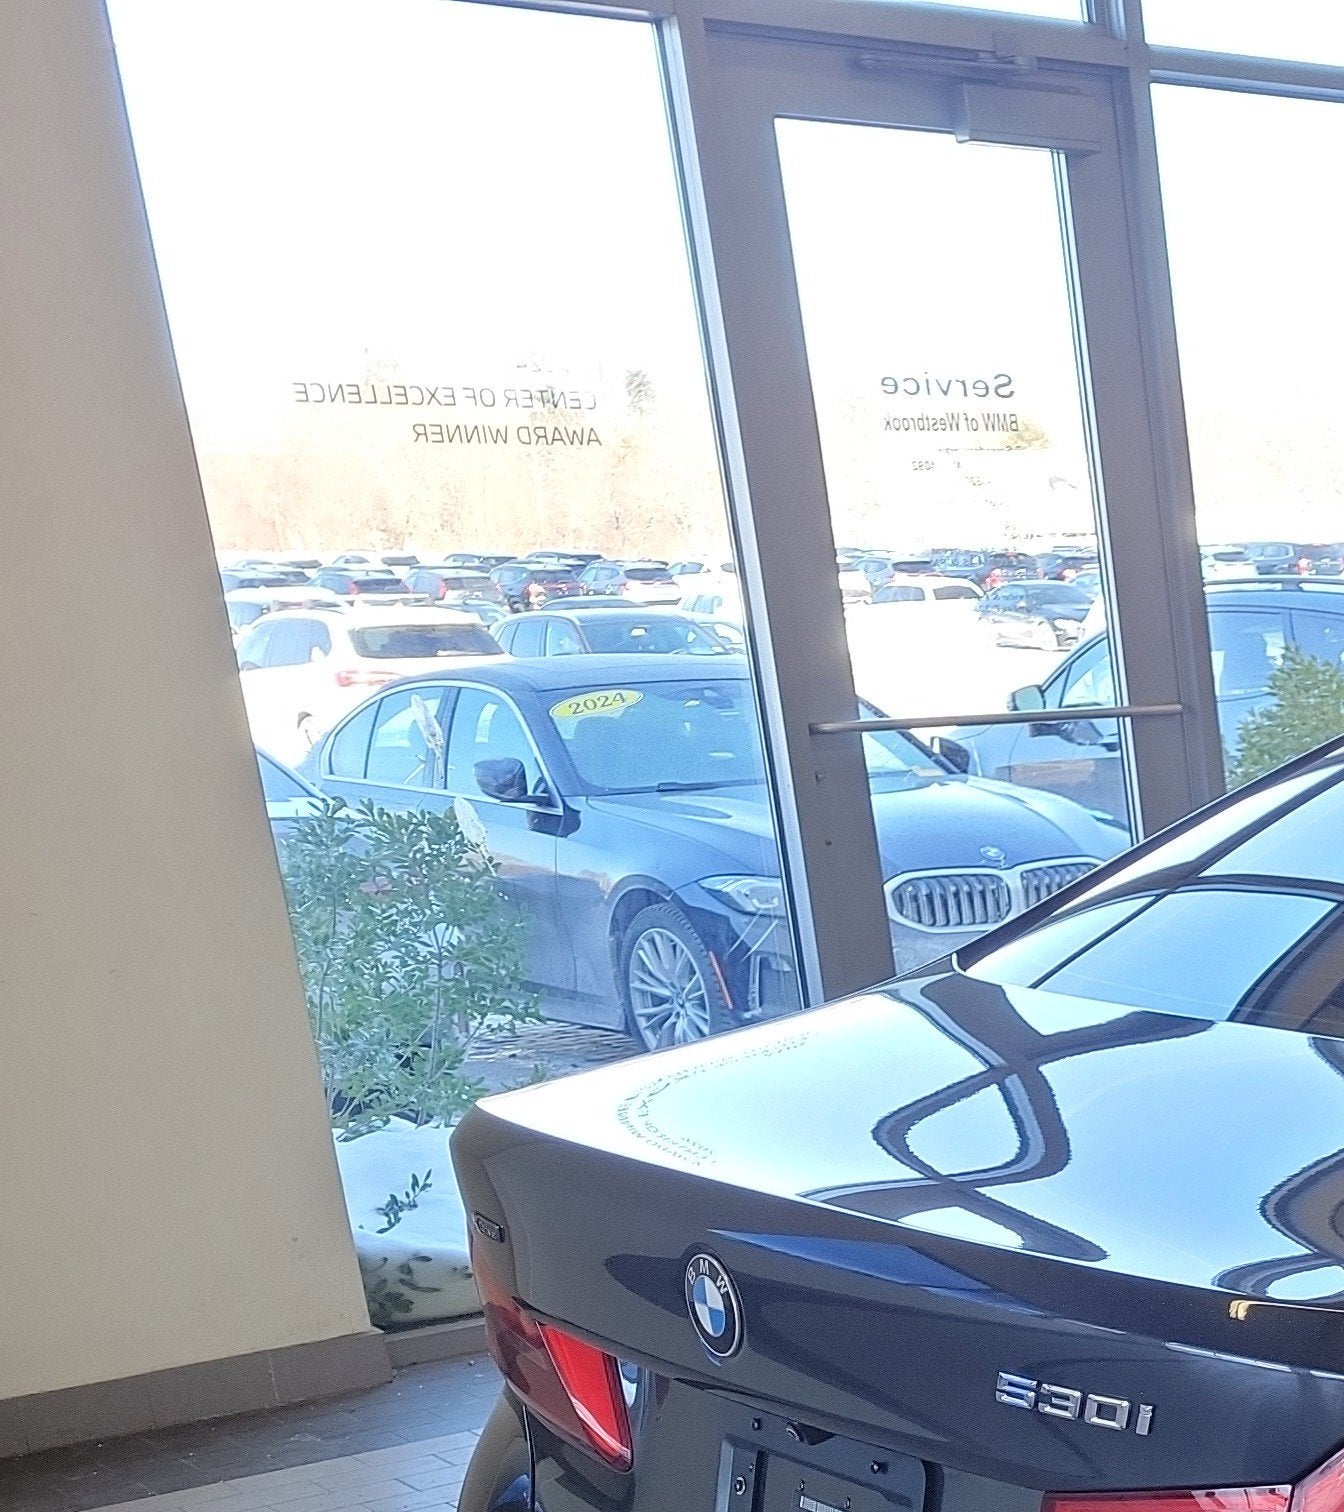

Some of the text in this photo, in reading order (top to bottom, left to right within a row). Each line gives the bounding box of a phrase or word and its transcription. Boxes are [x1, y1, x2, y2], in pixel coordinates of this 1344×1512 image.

[568, 692, 627, 715] 2024
[688, 1258, 728, 1294] BMW
[995, 1371, 1154, 1436] 530i
